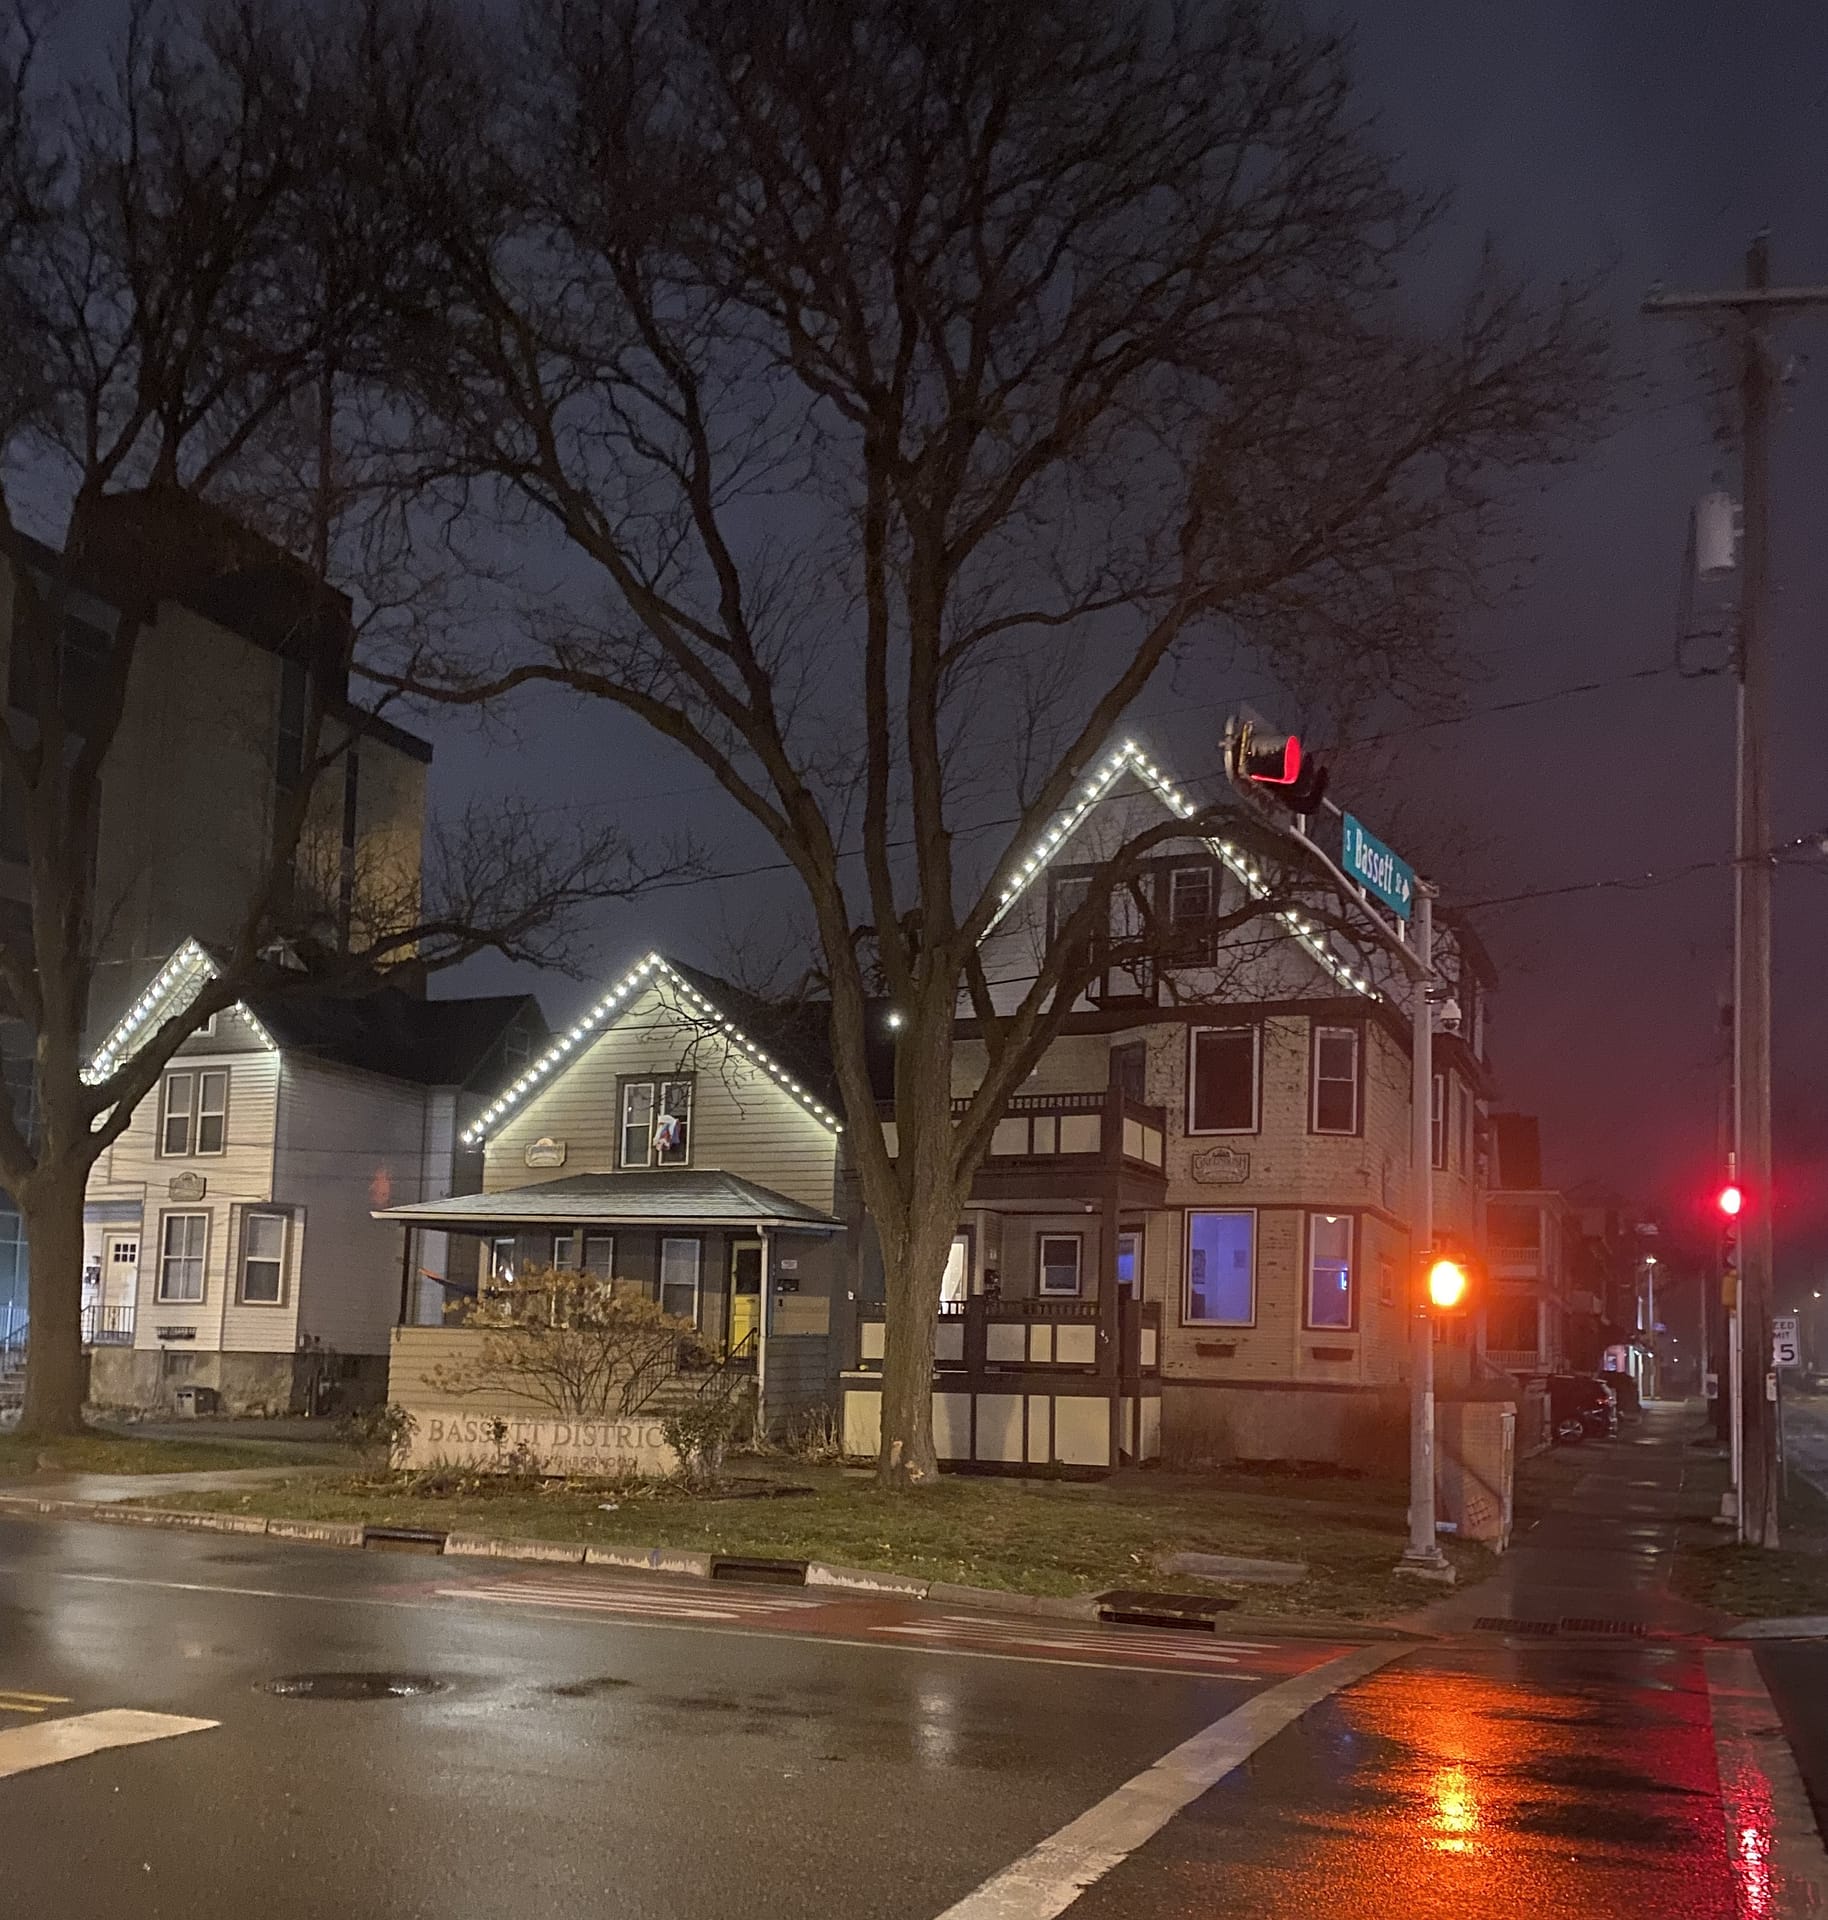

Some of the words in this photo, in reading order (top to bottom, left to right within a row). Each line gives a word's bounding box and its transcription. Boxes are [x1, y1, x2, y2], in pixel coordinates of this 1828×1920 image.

[1346, 829, 1351, 852] S
[1355, 828, 1394, 894] Bassett
[1774, 1321, 1794, 1330] EED
[1780, 1344, 1795, 1361] 5
[552, 1423, 663, 1449] DISTRIC
